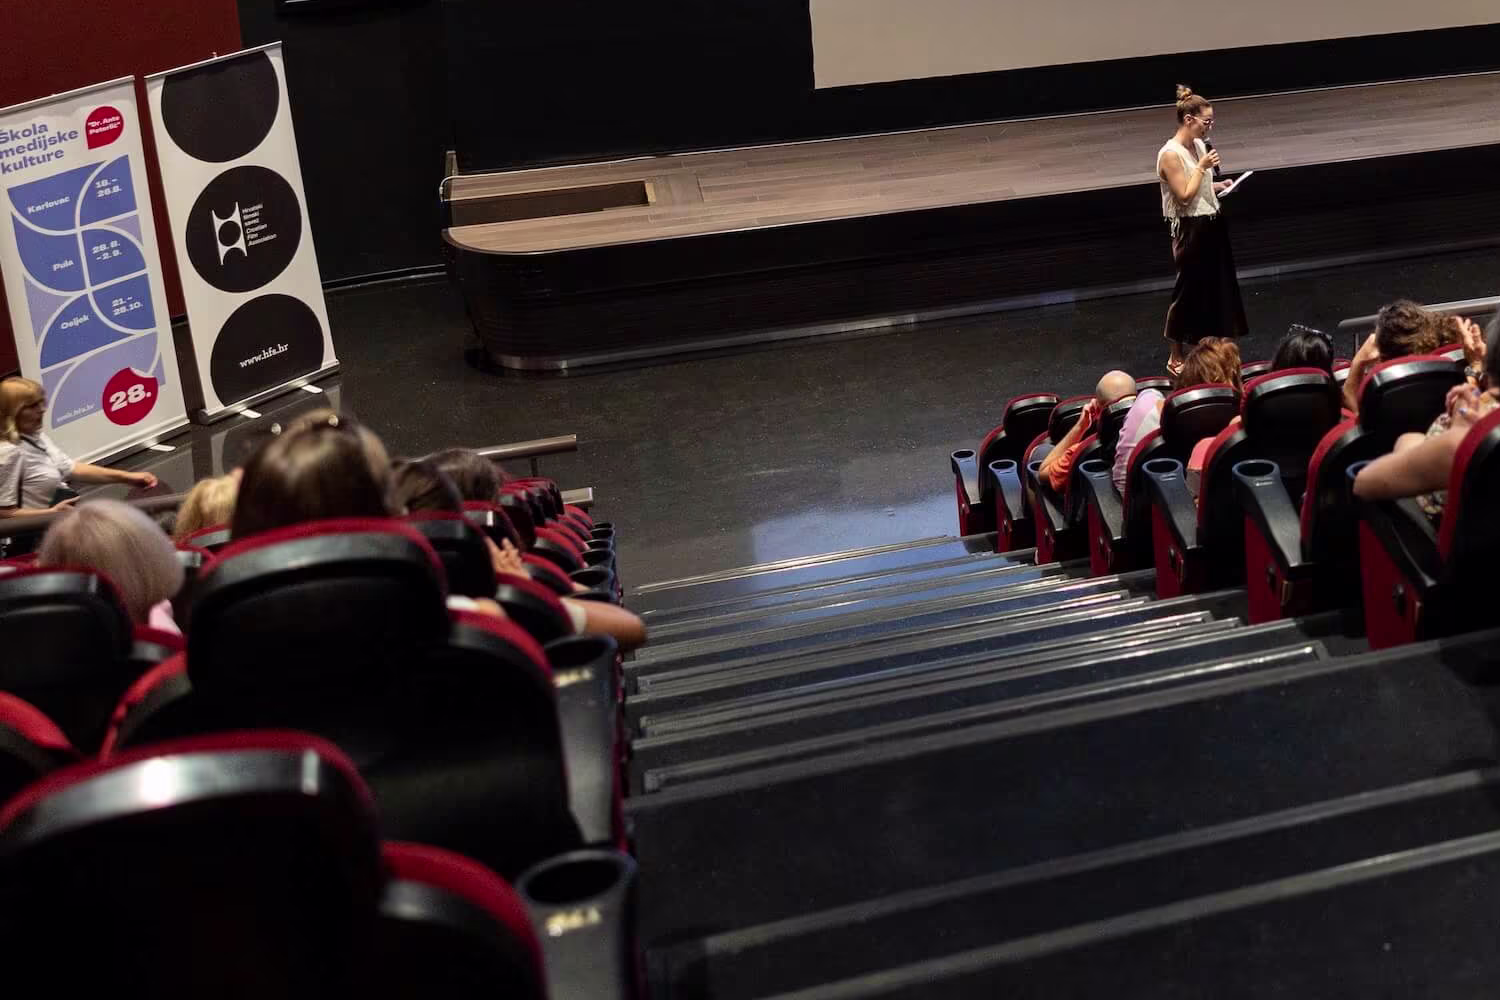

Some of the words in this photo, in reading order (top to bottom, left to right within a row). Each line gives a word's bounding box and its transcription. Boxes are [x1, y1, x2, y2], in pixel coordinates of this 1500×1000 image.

[0, 130, 78, 159] medijske
[1, 148, 65, 174] kulture
[27, 196, 70, 214] Karlovac
[52, 259, 74, 271] Pula
[60, 314, 90, 330] Osijek
[239, 343, 289, 368] www.hfs.hr
[109, 383, 152, 413] 28.
